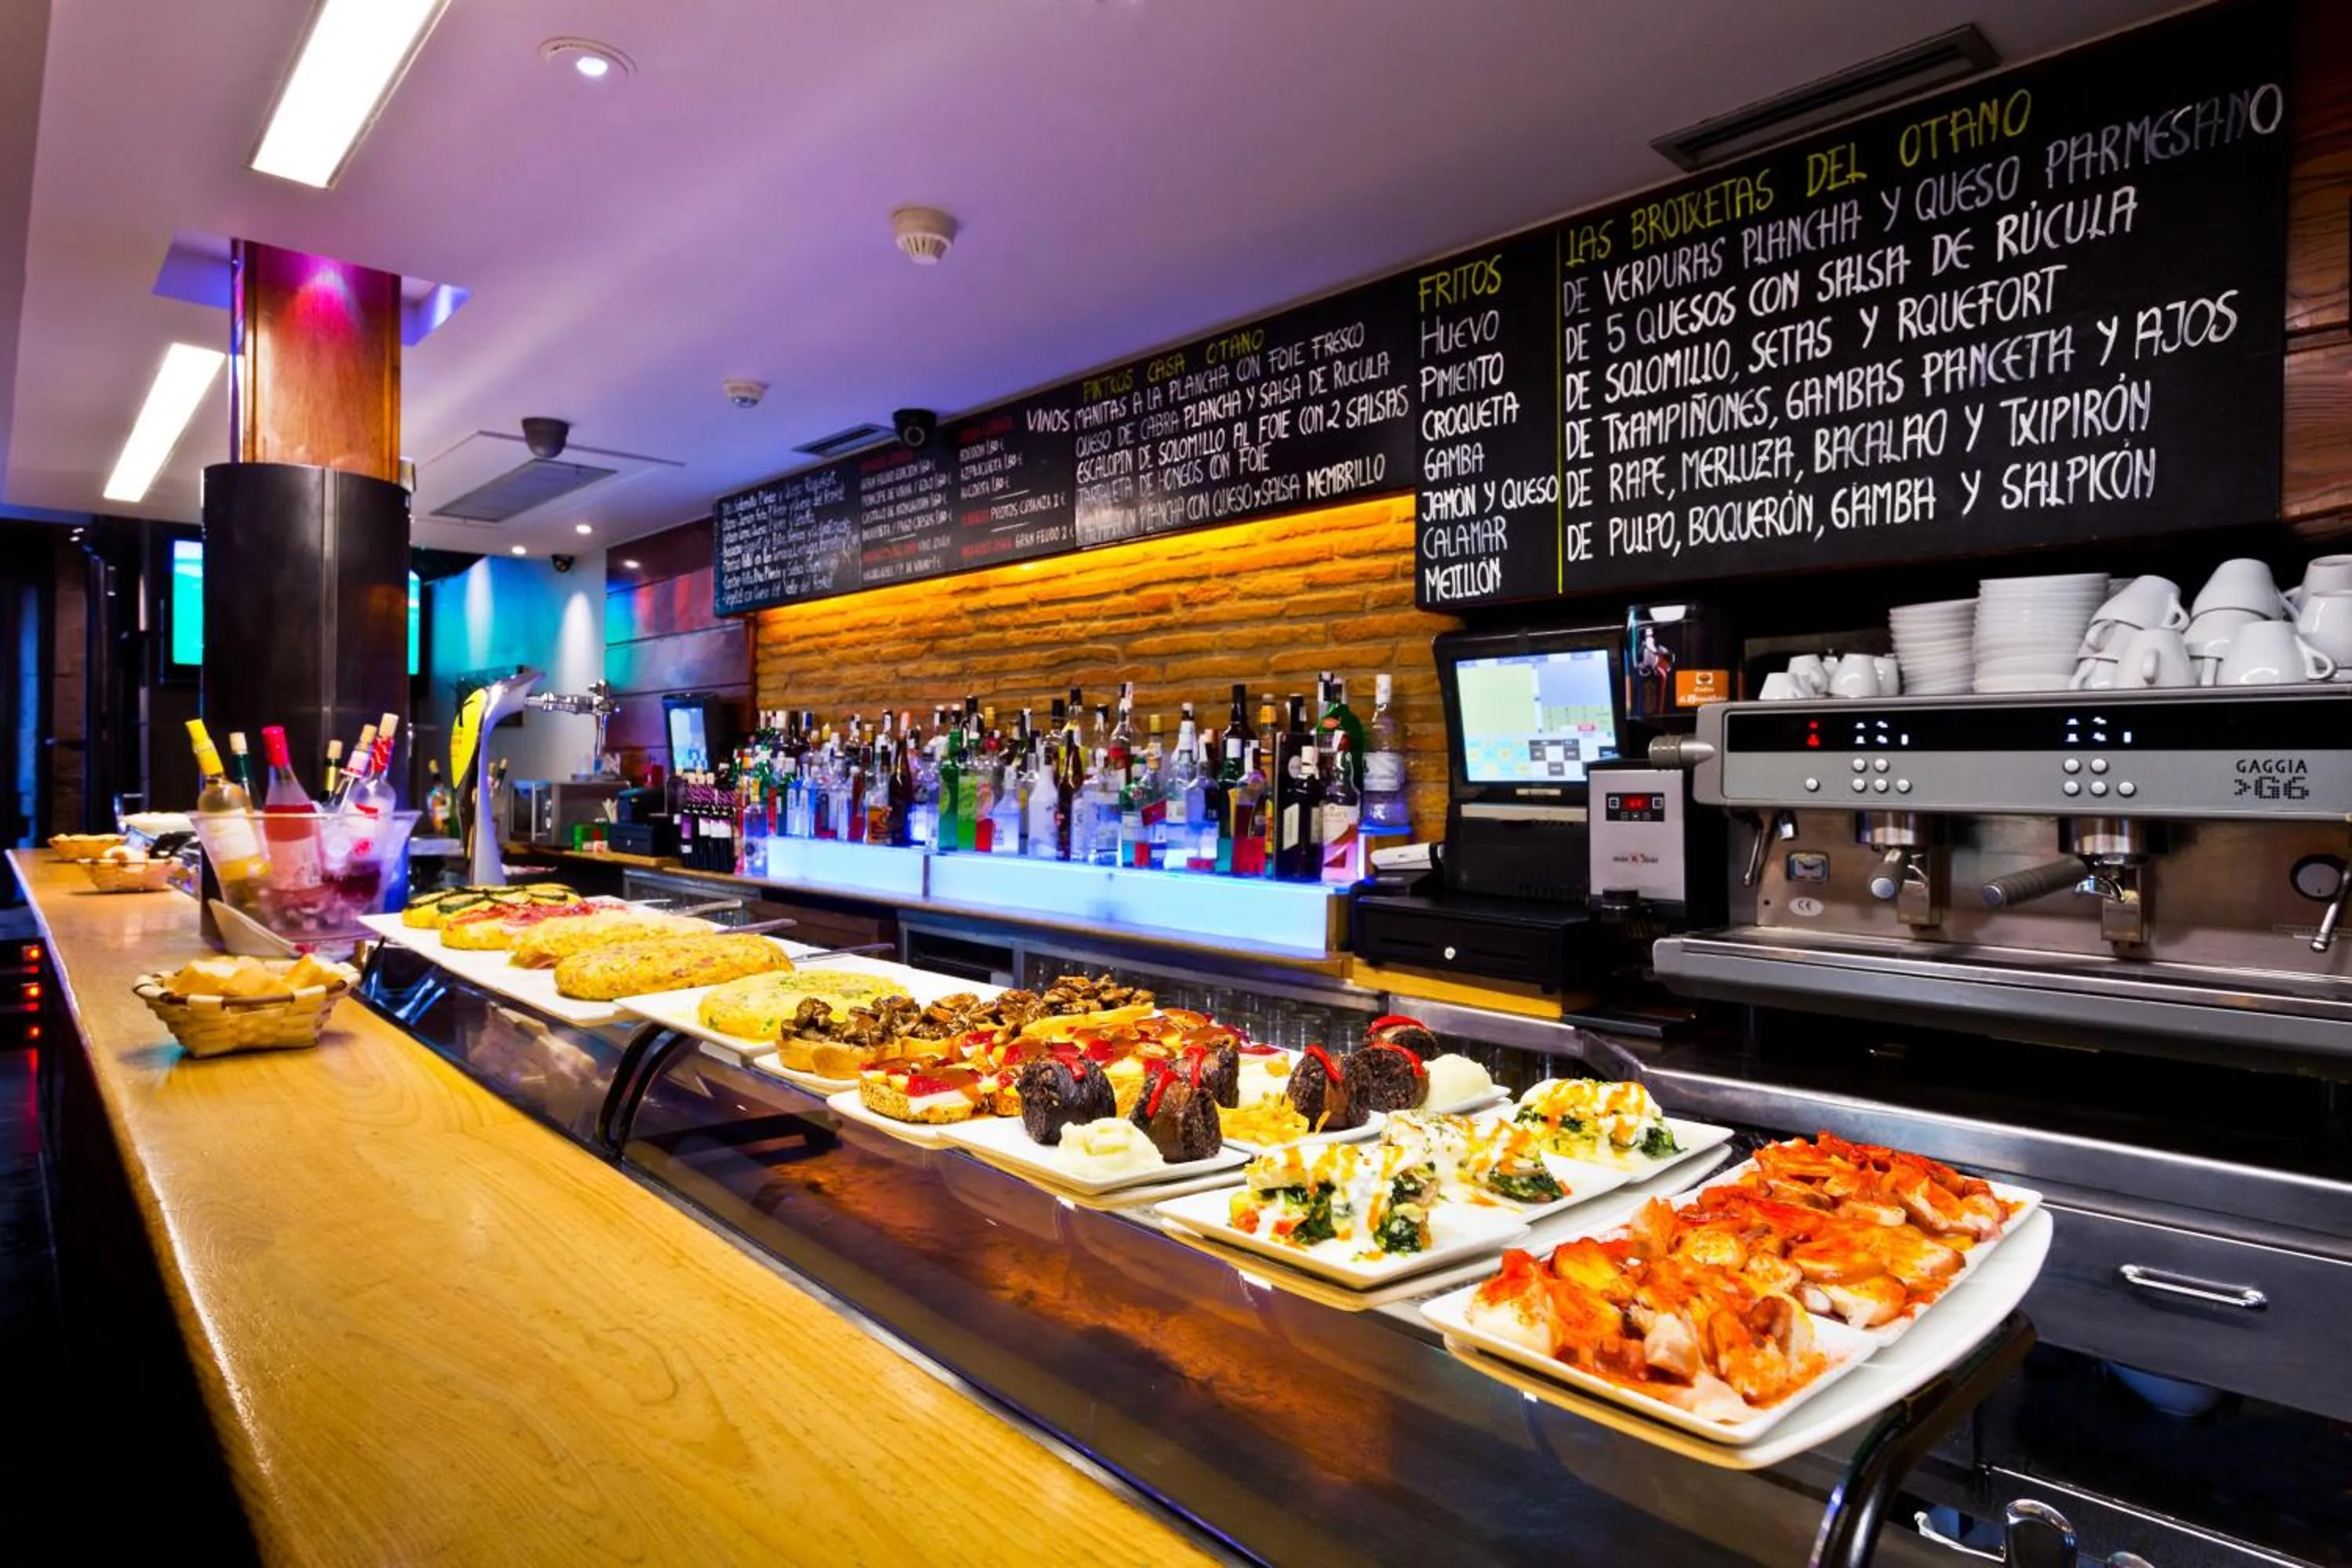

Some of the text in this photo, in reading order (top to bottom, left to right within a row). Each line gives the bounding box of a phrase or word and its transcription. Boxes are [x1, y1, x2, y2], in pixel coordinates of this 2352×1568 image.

[1563, 83, 2283, 317] DE VERDURAS PLANCHA Y QUESO PARMESANO
[1566, 89, 2031, 268] LAS BROTXETAS DEL OTANO
[1418, 253, 1502, 313] FRITOS
[1566, 185, 2138, 364] DE 5 QUESOS CON SALSA DE RÚCULA
[1147, 352, 1185, 383] CASA
[1205, 329, 1265, 365] OTANO
[1420, 310, 1500, 359] HUEVO
[1566, 264, 2067, 413] DE SOLOMILLO, SETAS Y RQUEFORT
[1074, 321, 1365, 430] MANITAS A LA PLANCHA CON FOIE FRESCO
[1076, 350, 1390, 458] QUESO DE CABRA PLANCHA Y SALSA DE RUCULA
[1420, 352, 1504, 402] PIMIENTO
[1566, 289, 2239, 461] DE TXAMPIÑONES, GAMBAS PANCETA Y AJOS
[1026, 408, 1071, 433] VINOS
[1076, 385, 1409, 484] ESCALOPIN DE SOLOMILLO AL FOIE CON 2 SALSAS
[1421, 391, 1520, 441] CROQUETA
[1566, 372, 2151, 510] DE RAPE, MERLUZA, BACALAO Y TXIPIRÓN
[1139, 471, 1154, 498] DE
[1158, 458, 1203, 491] HONGOS
[1210, 452, 1230, 481] CON
[1239, 441, 1272, 474] FOIE
[1187, 492, 1209, 521] CON
[1212, 483, 1253, 517] QUESO
[1261, 473, 1301, 506] SALSA
[1306, 452, 1386, 501] MEMBRILLO
[1424, 442, 1486, 481] GAMBA
[1421, 474, 1559, 523] JAMÓN Y QUESO
[1567, 437, 2157, 563] DE PULPO, BOQUERÓN, GAMBA Y SALPICÓN
[1423, 515, 1508, 560] CALAMAR
[1425, 556, 1502, 603] MEJILLÓN
[2235, 758, 2308, 774] GAGGIA
